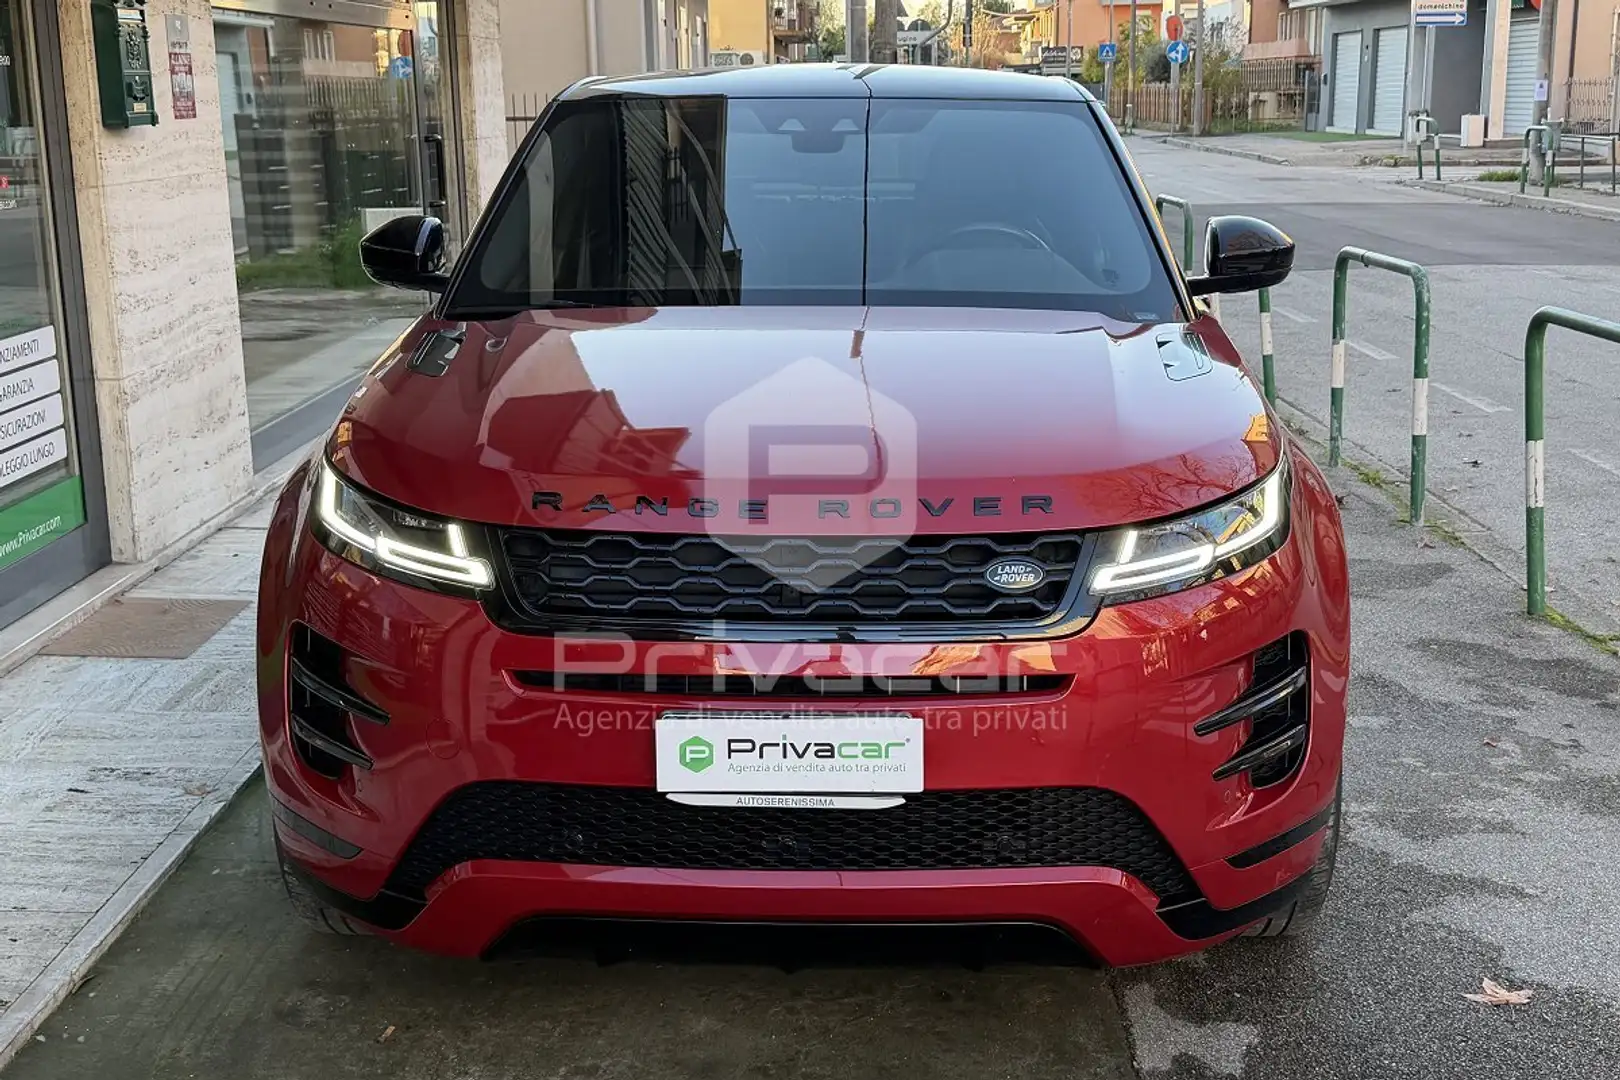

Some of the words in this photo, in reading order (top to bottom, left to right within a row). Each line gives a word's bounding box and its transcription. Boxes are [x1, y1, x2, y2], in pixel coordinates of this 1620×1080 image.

[0, 453, 28, 478] LEGGIO
[29, 441, 54, 465] LUNGO
[532, 491, 768, 519] RANGE
[817, 496, 1055, 518] ROVER
[997, 565, 1026, 574] LAND
[1000, 573, 1036, 582] ROVER
[727, 734, 906, 759] Privacar
[727, 763, 770, 775] Agenzia
[773, 762, 783, 773] di
[786, 762, 825, 773] vendita
[828, 764, 852, 773] auto
[855, 764, 870, 773] tra
[872, 763, 906, 775] privati
[736, 797, 835, 807] AUTOSERENISSIMA
